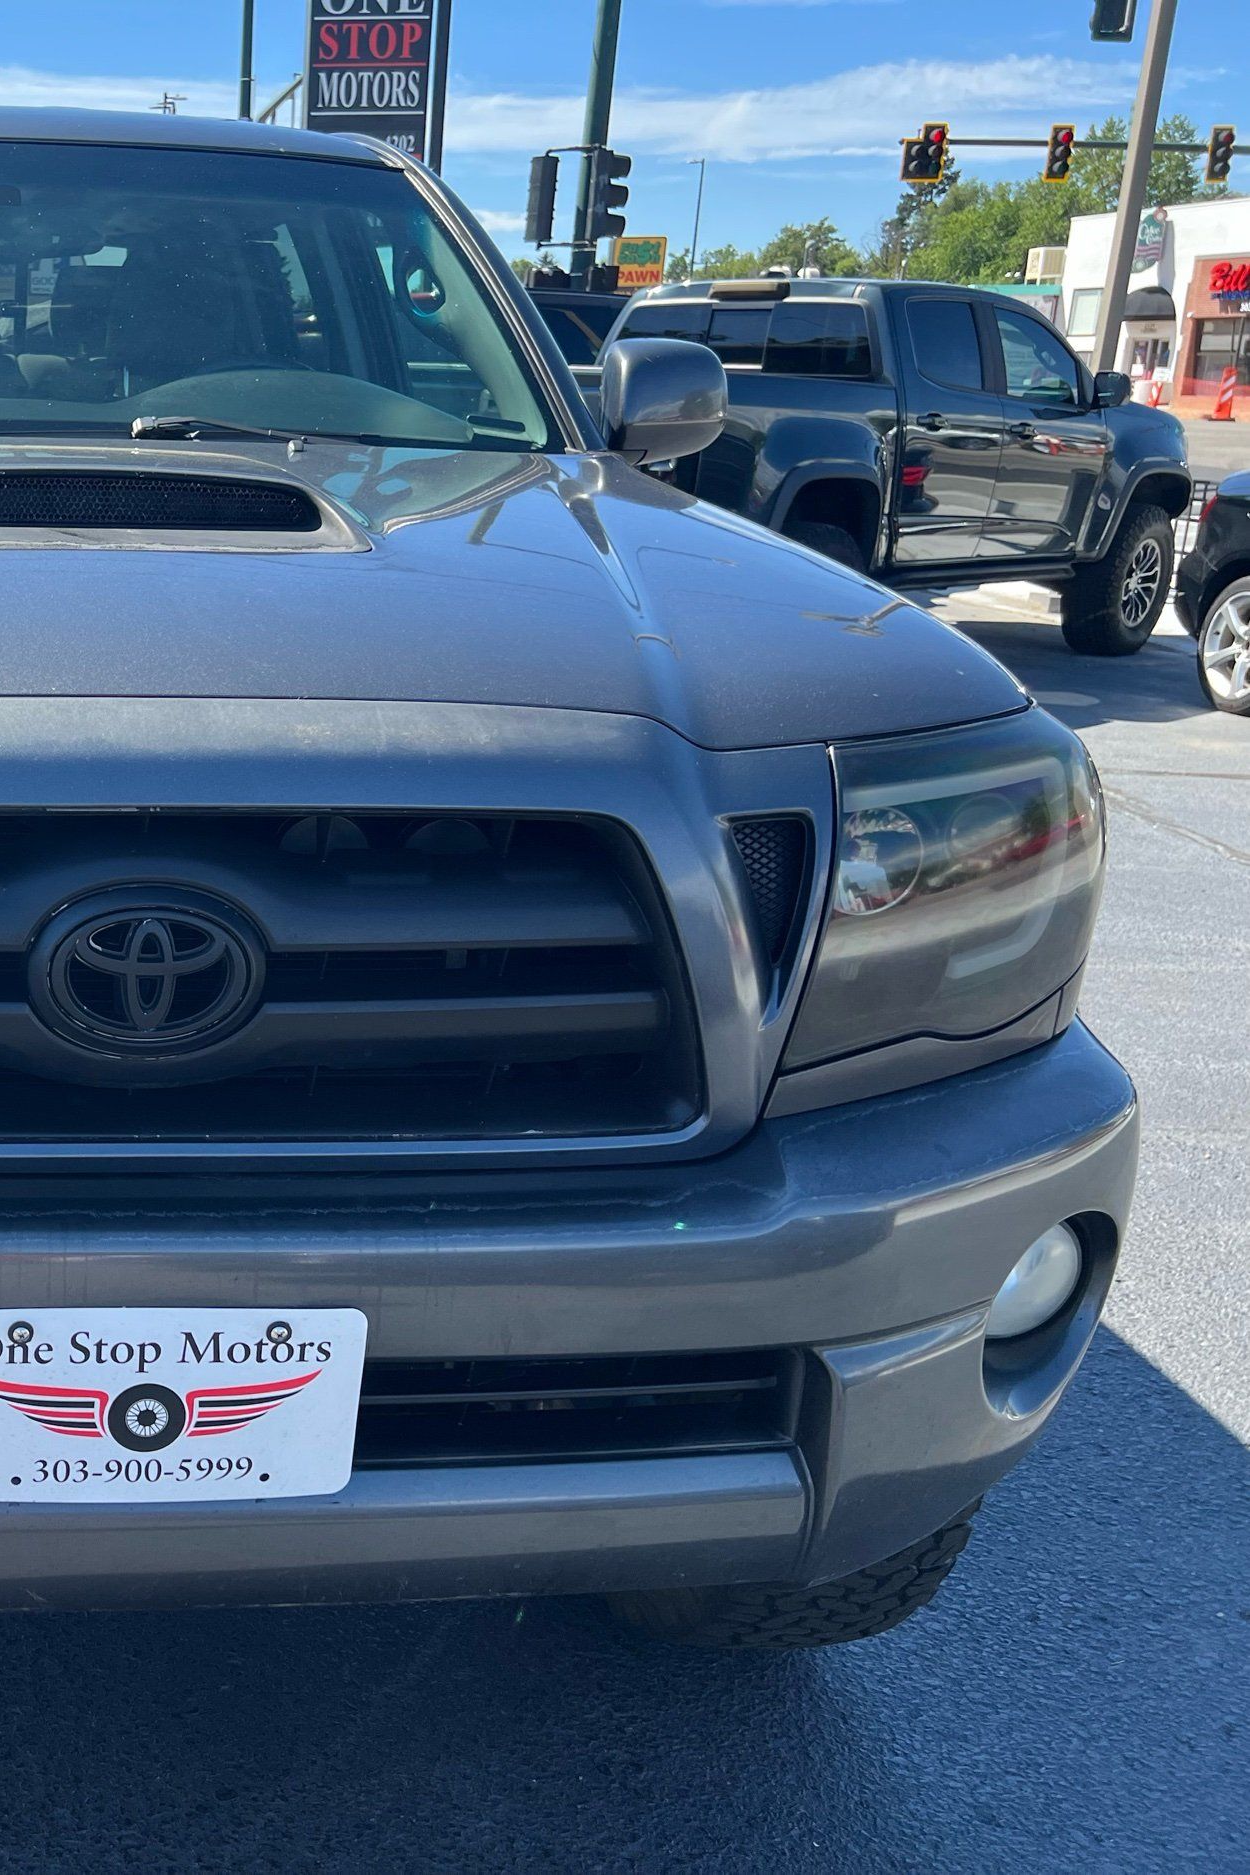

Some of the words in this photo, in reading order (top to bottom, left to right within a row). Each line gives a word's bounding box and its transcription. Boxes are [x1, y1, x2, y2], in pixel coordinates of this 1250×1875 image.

[318, 22, 423, 60] STOP
[316, 70, 421, 108] MOTORS
[69, 1331, 162, 1374] Stop
[176, 1331, 332, 1365] Motors
[32, 1456, 254, 1483] 303-900-5999
